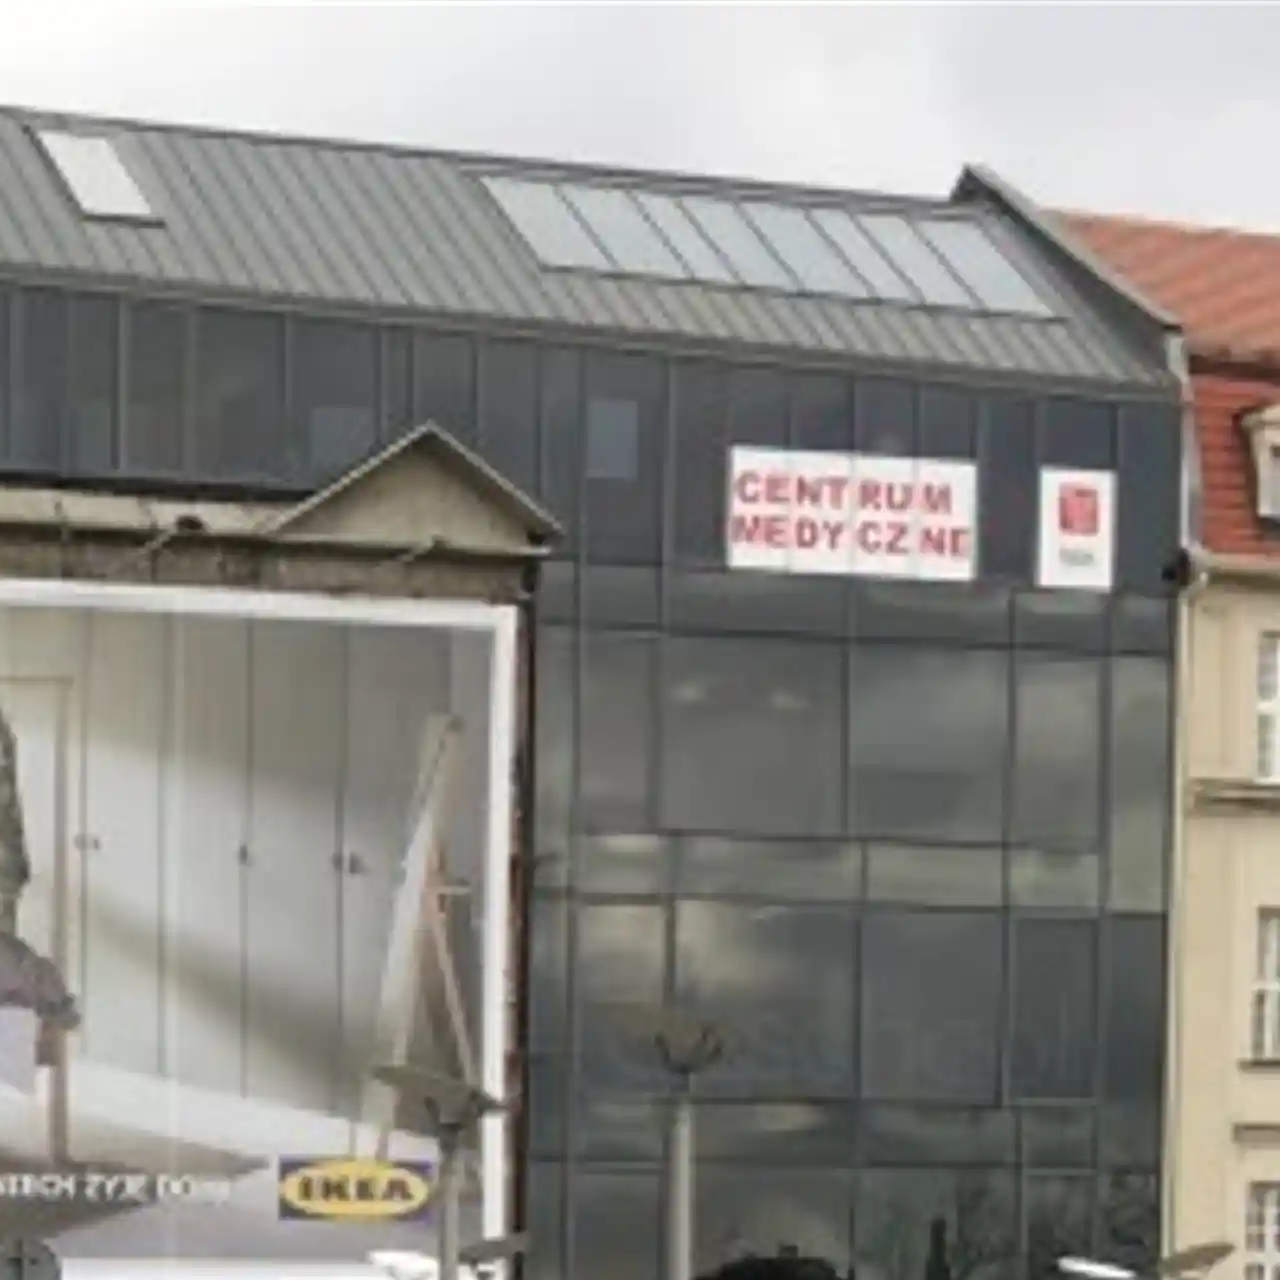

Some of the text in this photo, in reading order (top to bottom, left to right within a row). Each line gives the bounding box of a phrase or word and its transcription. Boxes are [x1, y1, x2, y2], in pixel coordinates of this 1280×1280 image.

[733, 469, 953, 515] CENTRUM
[729, 514, 972, 556] MEDYCZNE
[296, 1174, 416, 1203] IKEA
